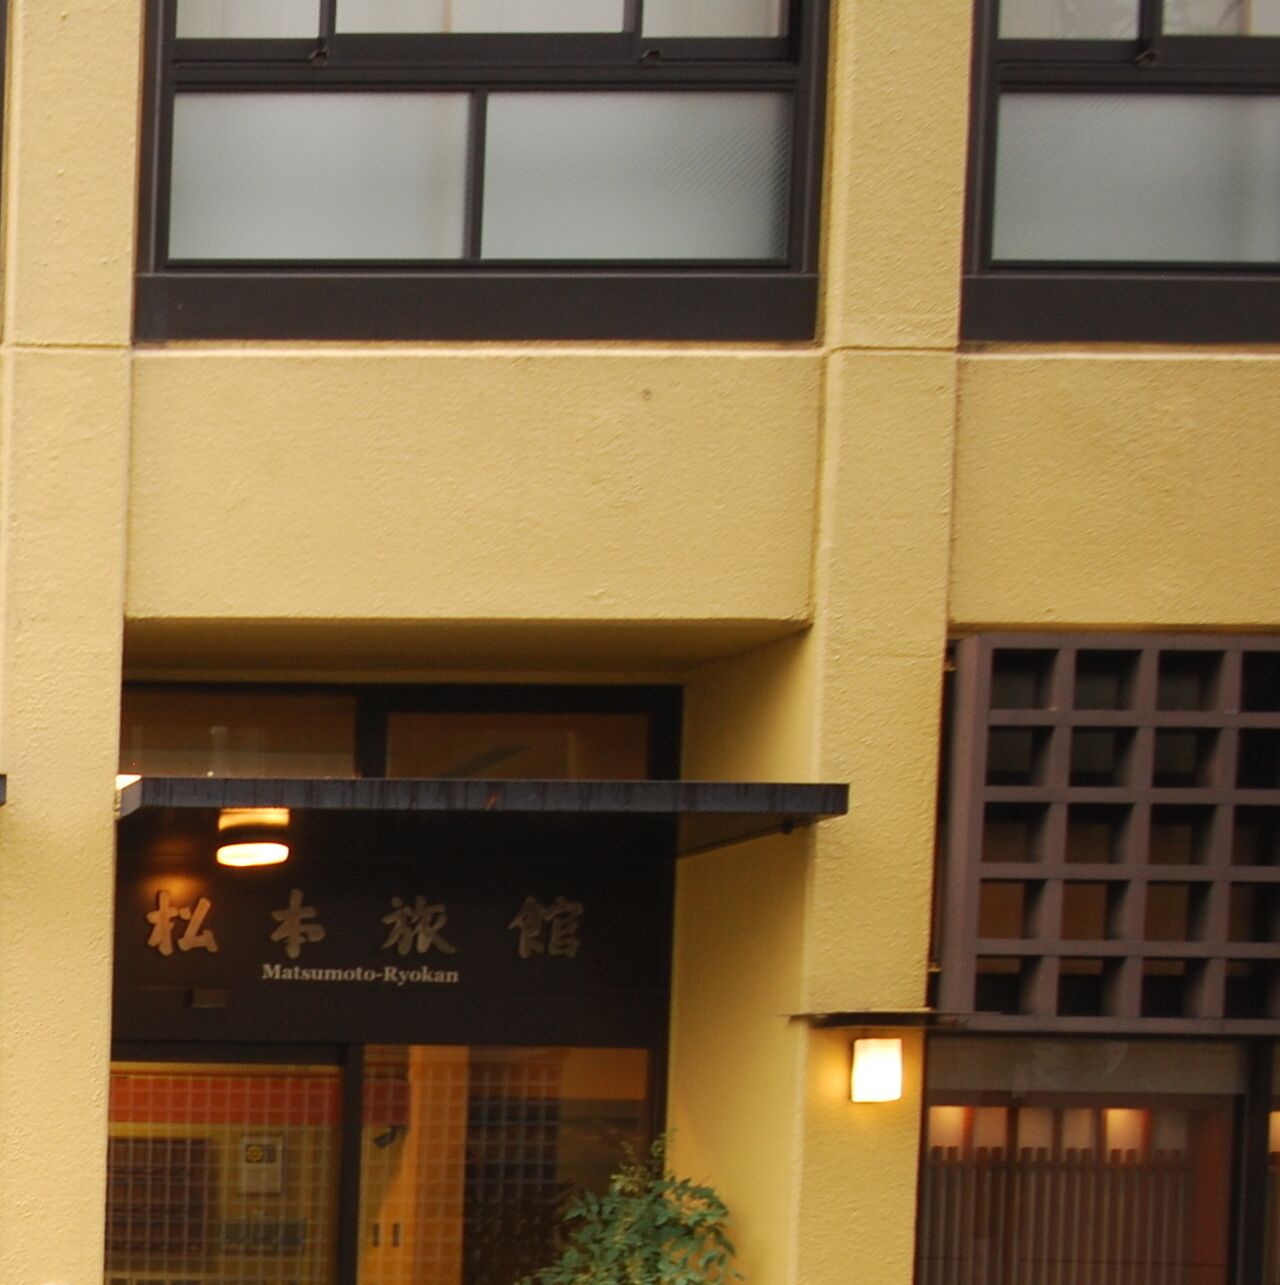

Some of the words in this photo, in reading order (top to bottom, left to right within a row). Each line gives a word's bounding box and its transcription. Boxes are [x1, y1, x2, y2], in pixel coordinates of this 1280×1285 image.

[147, 890, 583, 958] 松本旅館
[261, 963, 460, 987] Matsumoto-Ryokan
